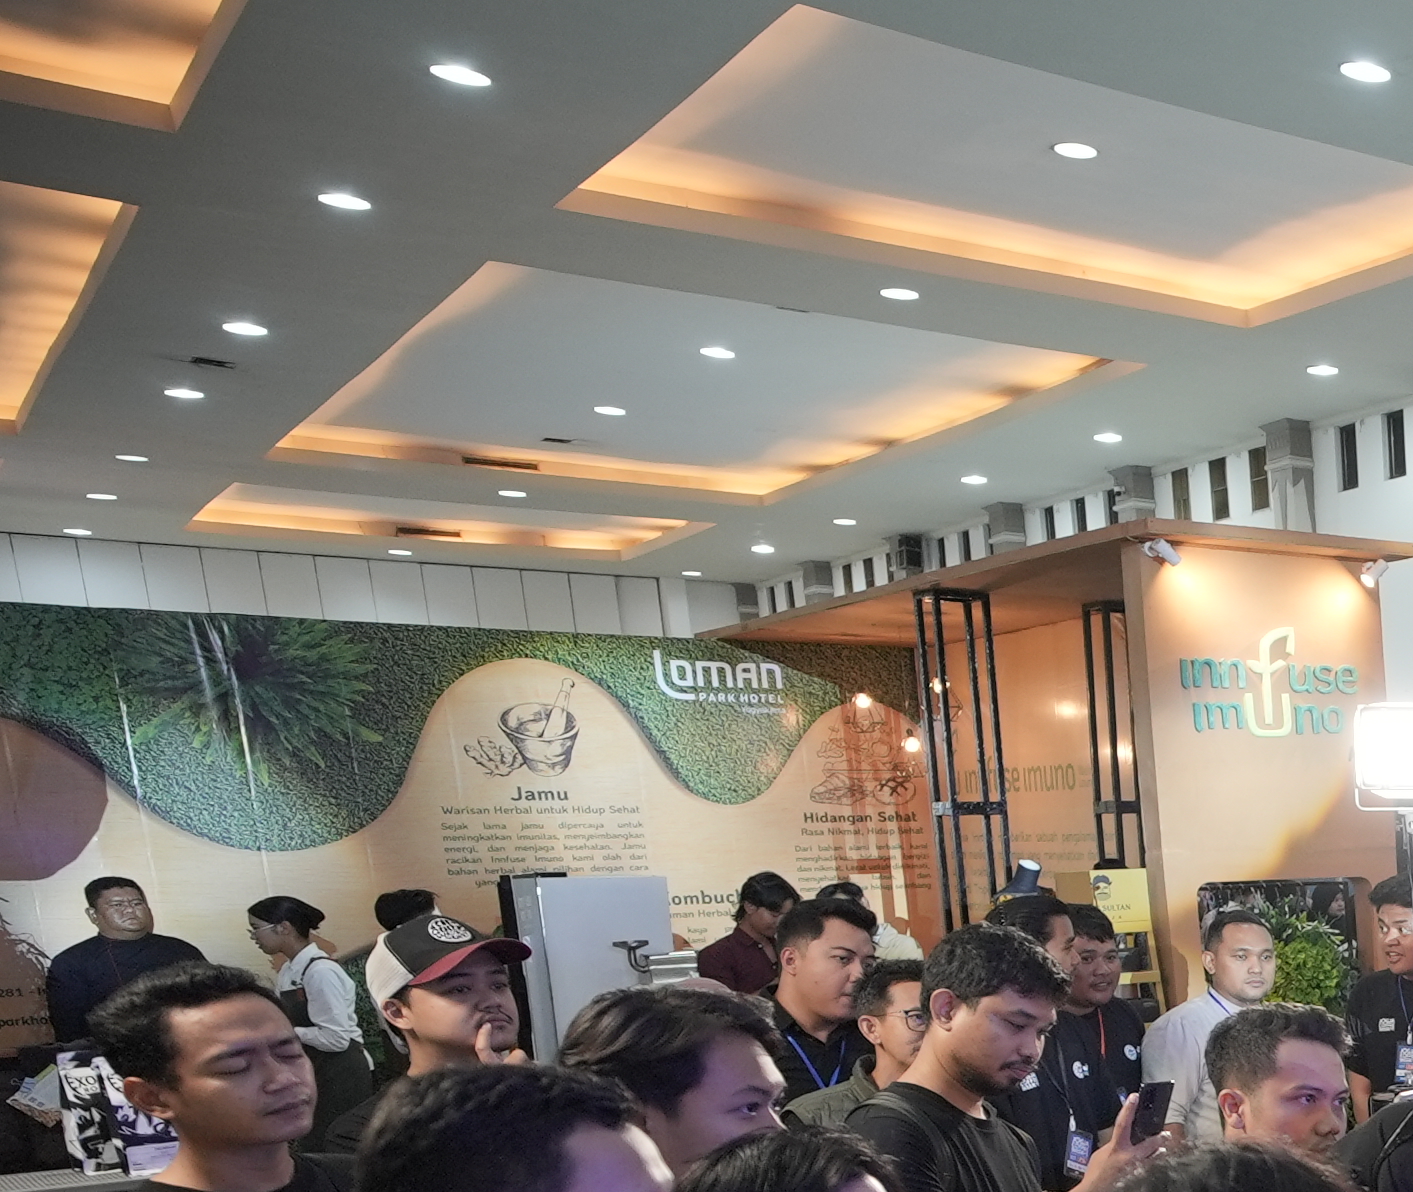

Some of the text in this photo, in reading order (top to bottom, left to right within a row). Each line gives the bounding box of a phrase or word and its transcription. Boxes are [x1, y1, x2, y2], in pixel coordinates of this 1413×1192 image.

[699, 692, 784, 704] PARK HOTEL
[1193, 692, 1344, 737] imuno
[1023, 762, 1076, 793] imuno
[511, 786, 569, 802] Jamu
[441, 805, 641, 816] Warisan Herbal untuk Hidup Sehat
[803, 811, 918, 824] Hidangan Sehat
[441, 822, 469, 832] Sejak
[483, 822, 507, 830] lama
[521, 822, 544, 832] jamu
[801, 828, 824, 836] Rasa
[867, 826, 895, 837] Hidup
[898, 826, 924, 835] Sehat
[668, 888, 741, 906] ombuc
[1101, 903, 1131, 911] SULTAN
[697, 908, 732, 919] Herbal
